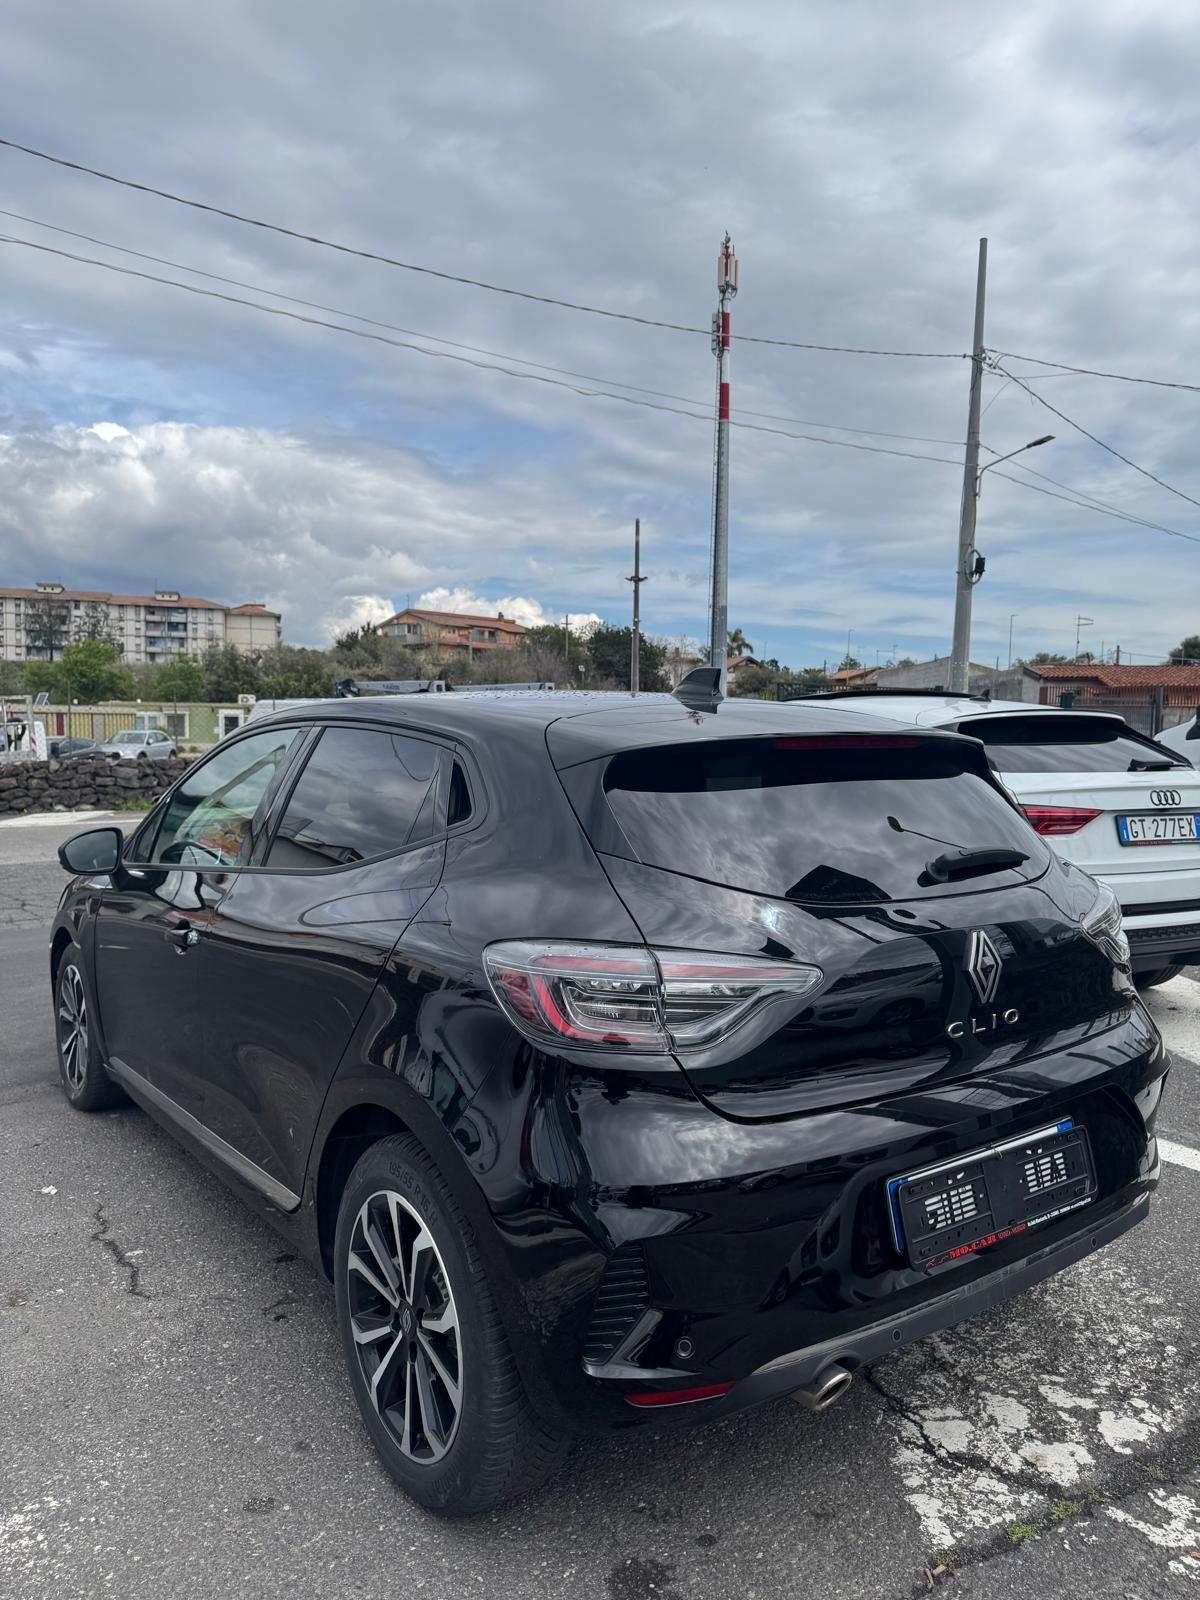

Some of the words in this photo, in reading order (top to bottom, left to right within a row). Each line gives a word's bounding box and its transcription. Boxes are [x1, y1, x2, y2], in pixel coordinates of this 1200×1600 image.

[1129, 818, 1146, 839] GT
[1151, 817, 1195, 838] 277EX
[947, 1008, 1019, 1039] CLIO
